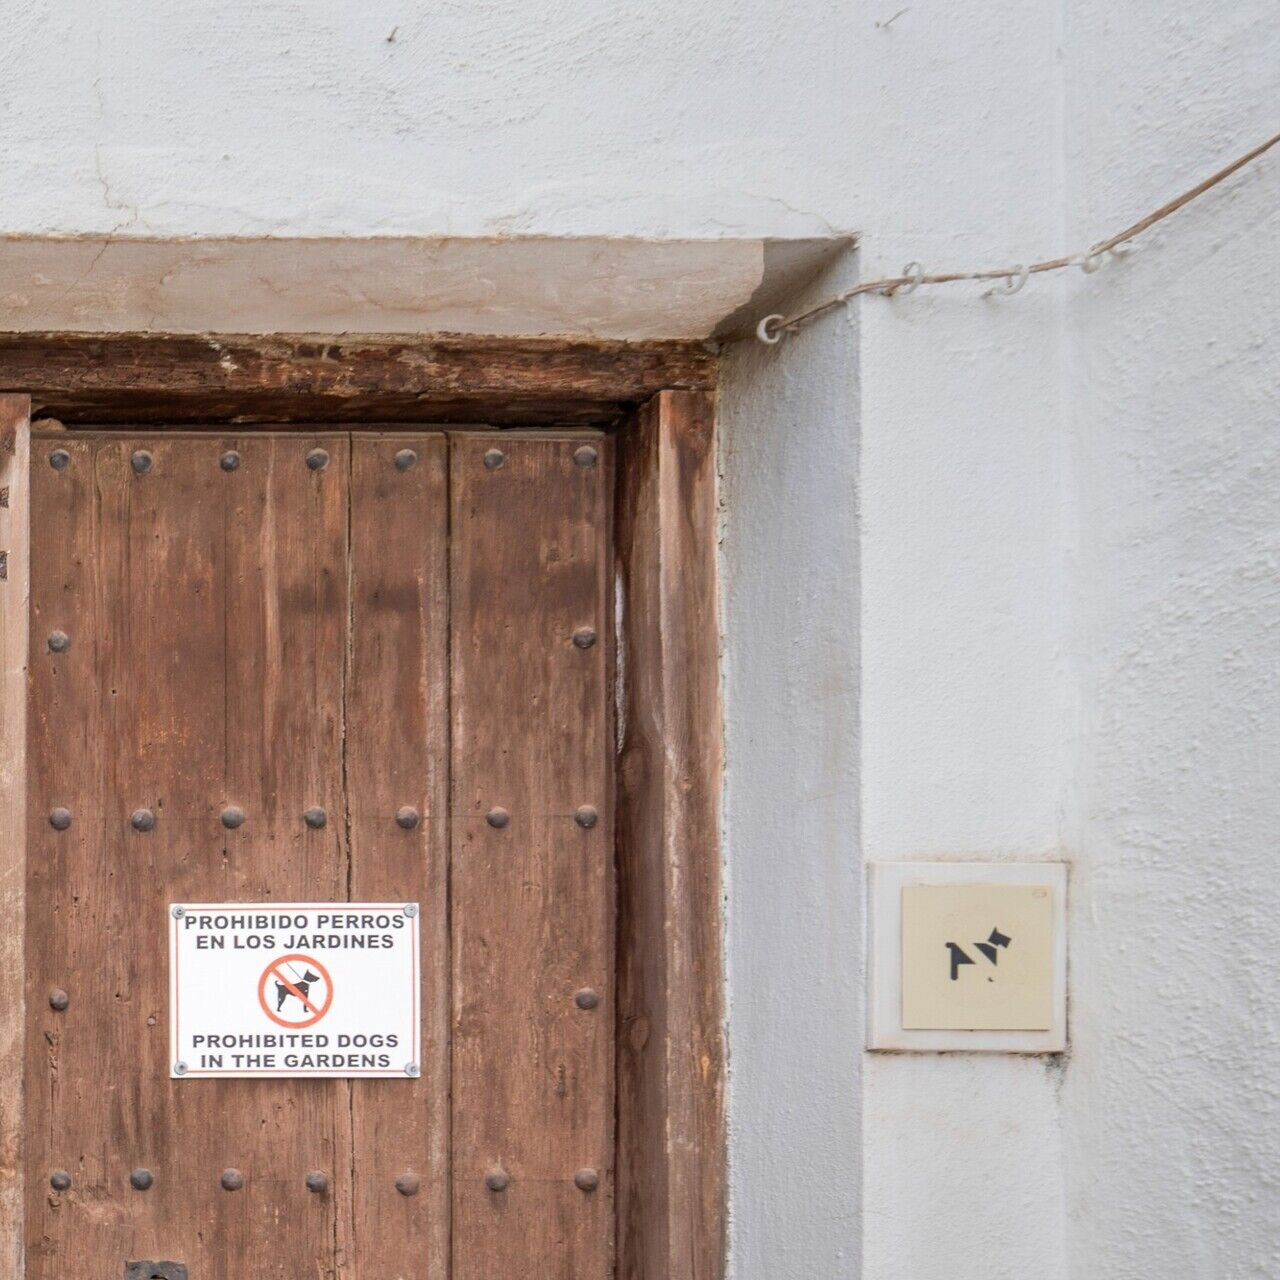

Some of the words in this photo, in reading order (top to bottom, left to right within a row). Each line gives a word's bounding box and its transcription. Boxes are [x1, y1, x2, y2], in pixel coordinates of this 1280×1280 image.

[185, 915, 308, 929] PROHIBIDO
[317, 915, 405, 929] PERROS
[196, 935, 225, 949] EN
[233, 935, 276, 949] LOS
[284, 935, 394, 949] JARDINES
[192, 1035, 329, 1048] PROHIBITED
[337, 1034, 399, 1048] DOGS
[200, 1055, 223, 1068] IN
[231, 1055, 276, 1068] THE
[284, 1054, 390, 1068] GARDENS
